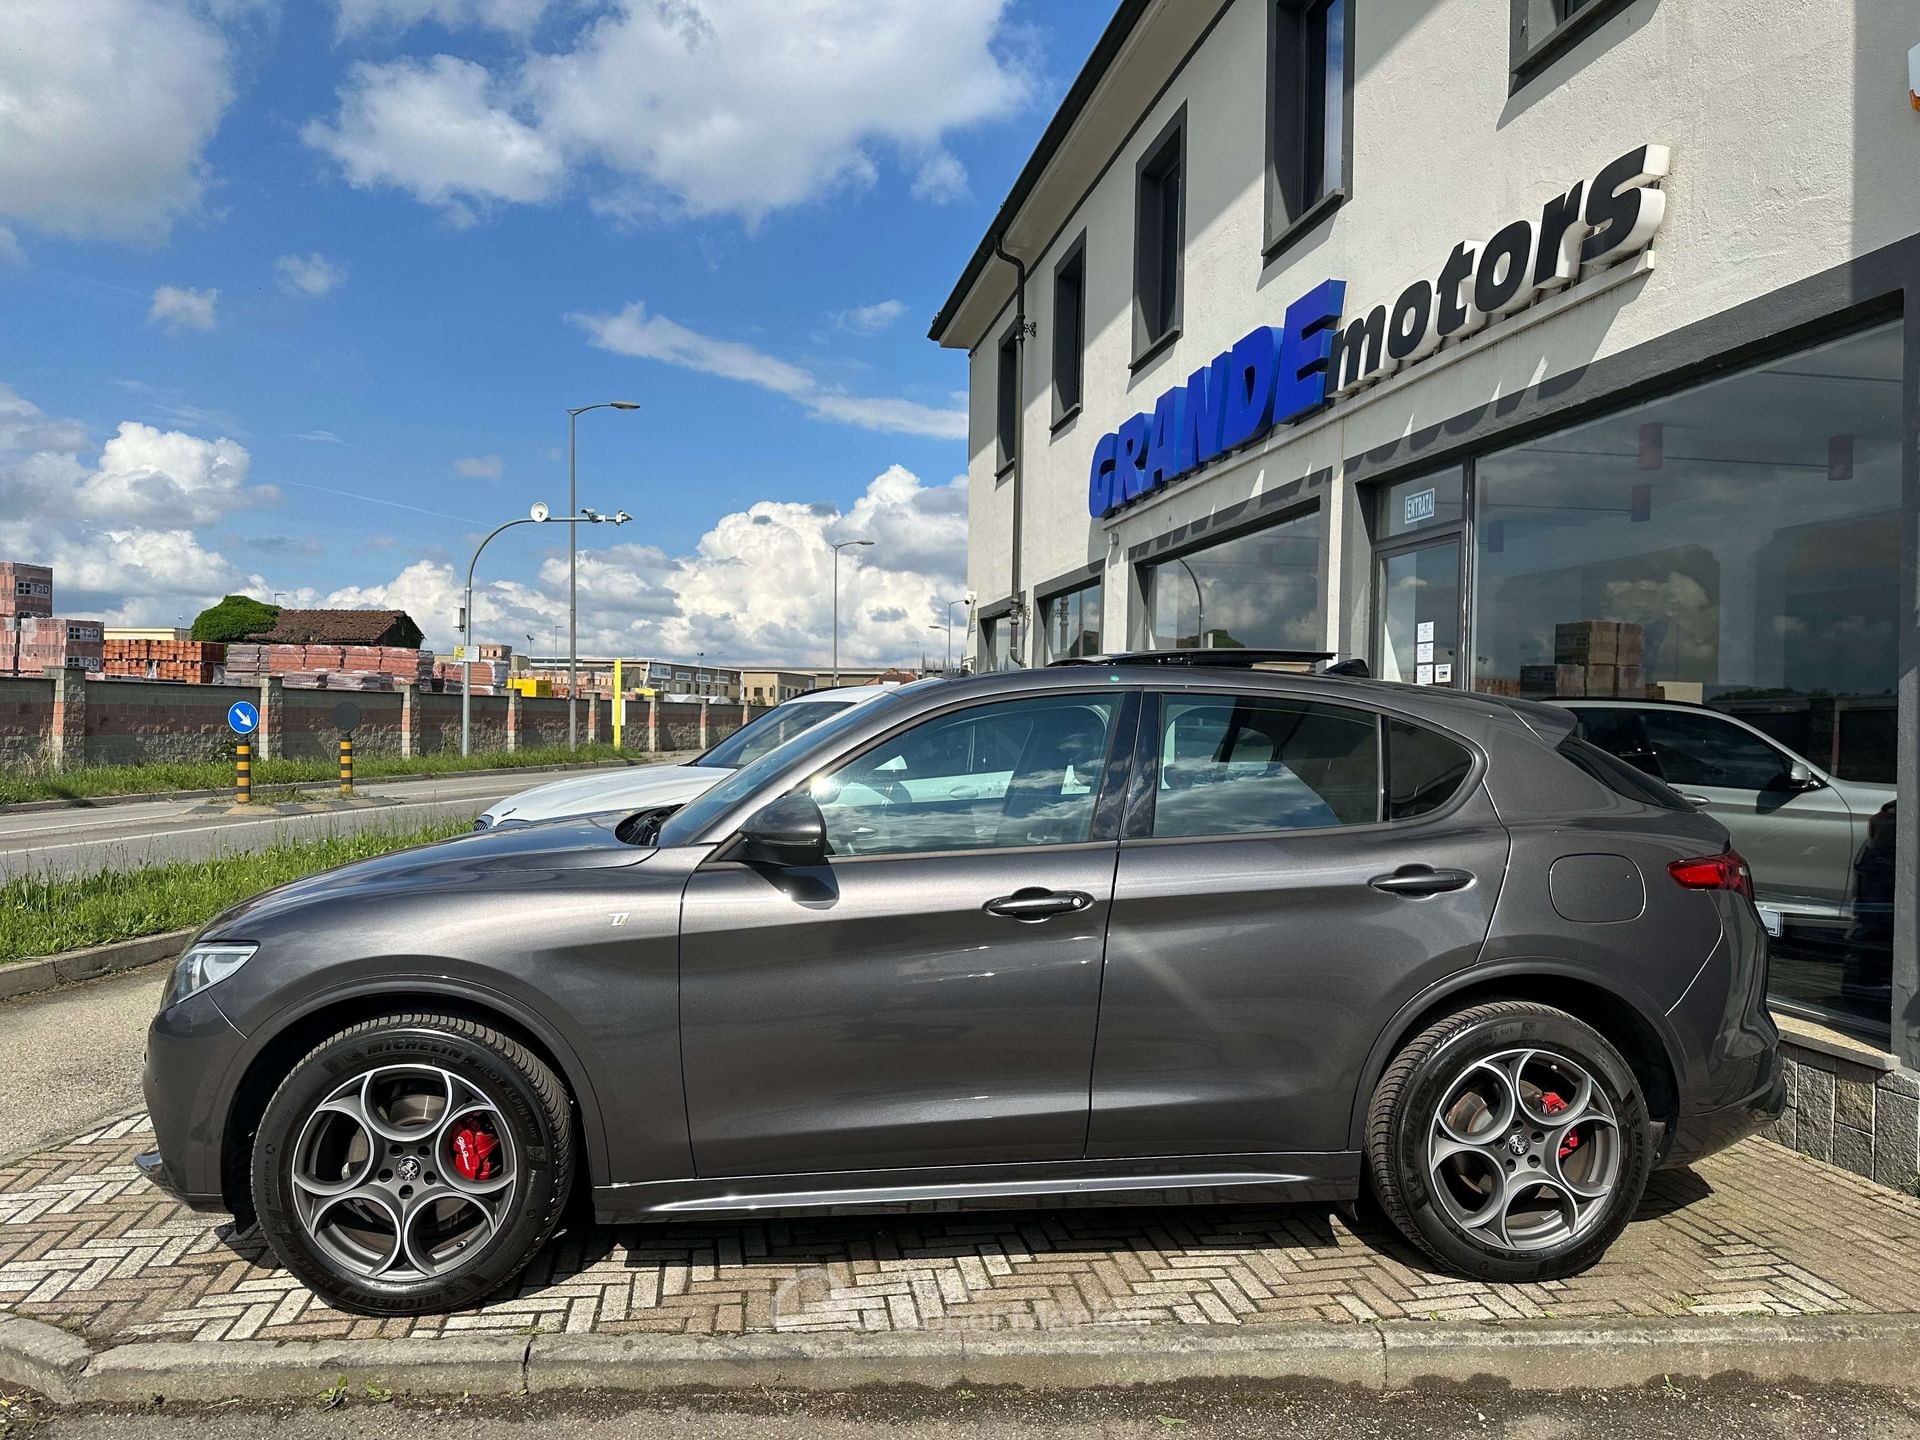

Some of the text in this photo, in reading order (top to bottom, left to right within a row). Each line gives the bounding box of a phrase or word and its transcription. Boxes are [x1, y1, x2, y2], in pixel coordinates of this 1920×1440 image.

[1089, 144, 1669, 519] GRANDE motors
[1407, 492, 1433, 519] ENTRATA
[32, 584, 49, 595] T2D
[82, 628, 99, 639] T2D
[81, 657, 99, 667] T2D
[368, 1039, 464, 1062] MICHELIN
[473, 1063, 506, 1085] PILOT
